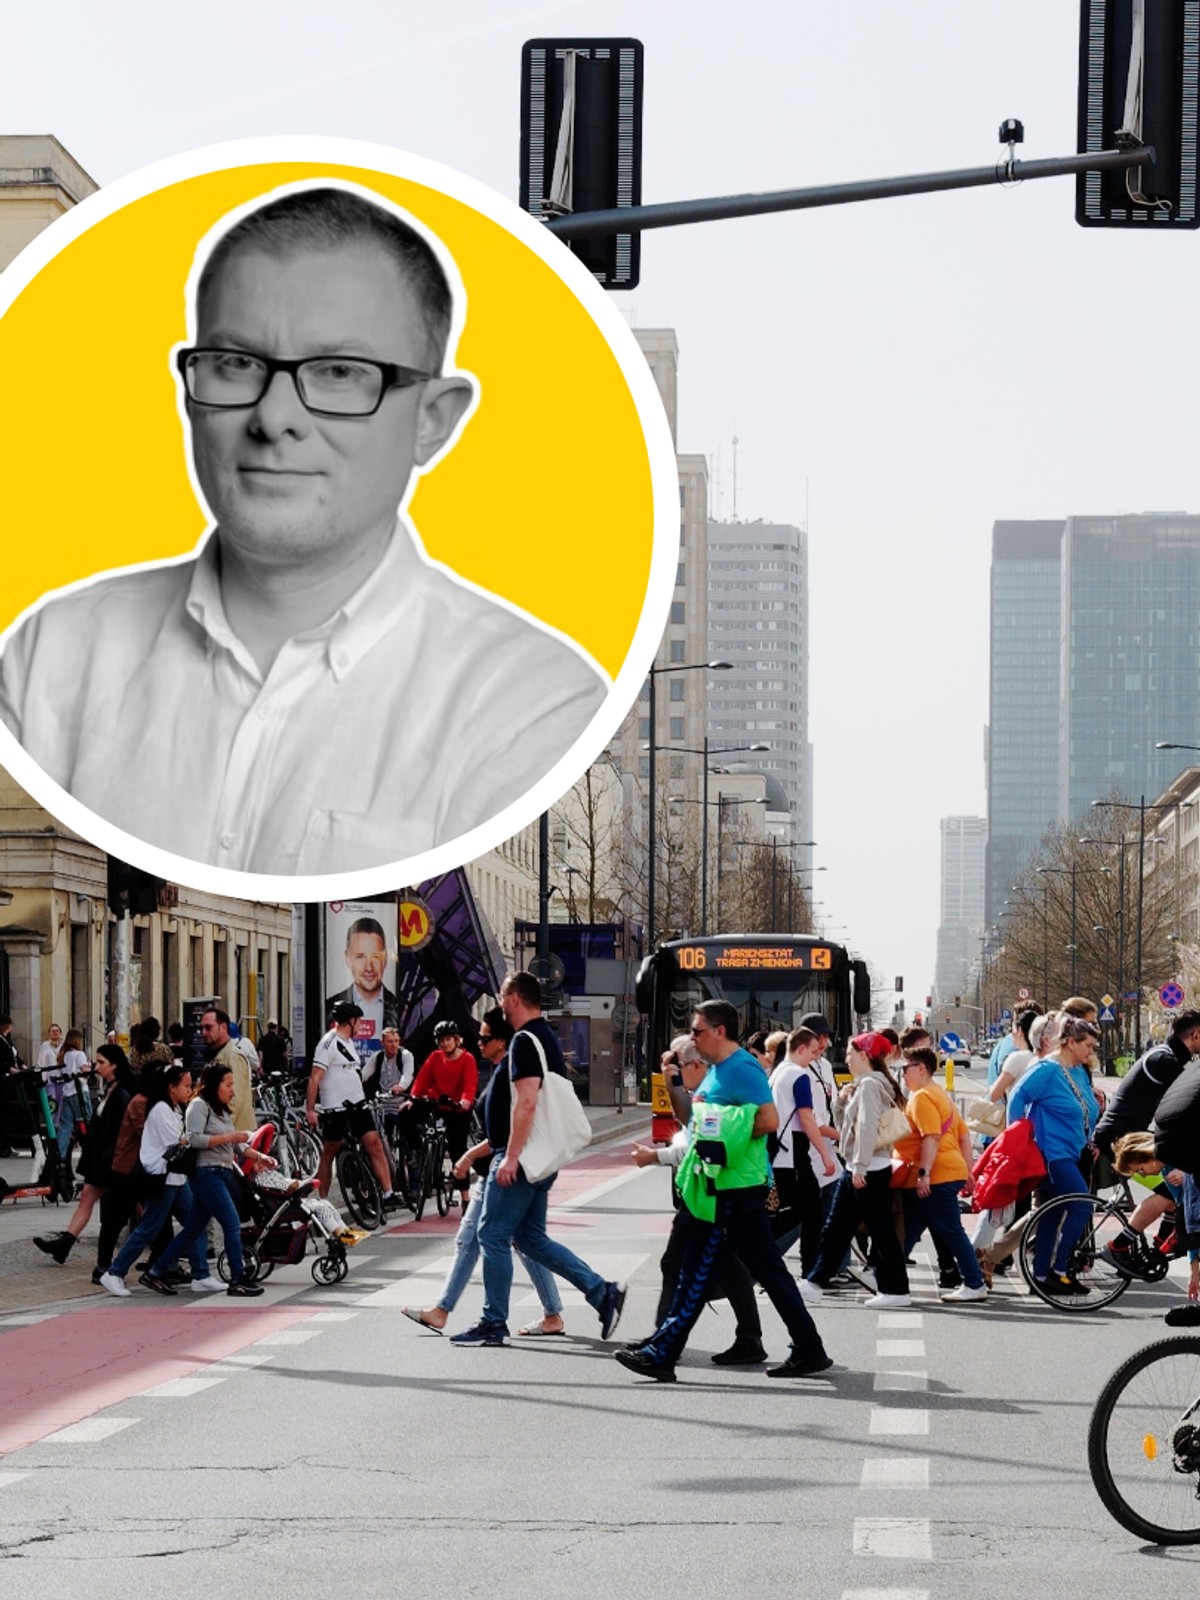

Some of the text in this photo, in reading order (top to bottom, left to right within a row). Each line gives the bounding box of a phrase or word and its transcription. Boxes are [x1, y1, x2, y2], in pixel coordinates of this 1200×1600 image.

[400, 910, 423, 938] M
[678, 948, 706, 969] 106
[723, 948, 794, 957] MARIENSZTAT
[716, 958, 803, 967] TRASA ZMIENIONA
